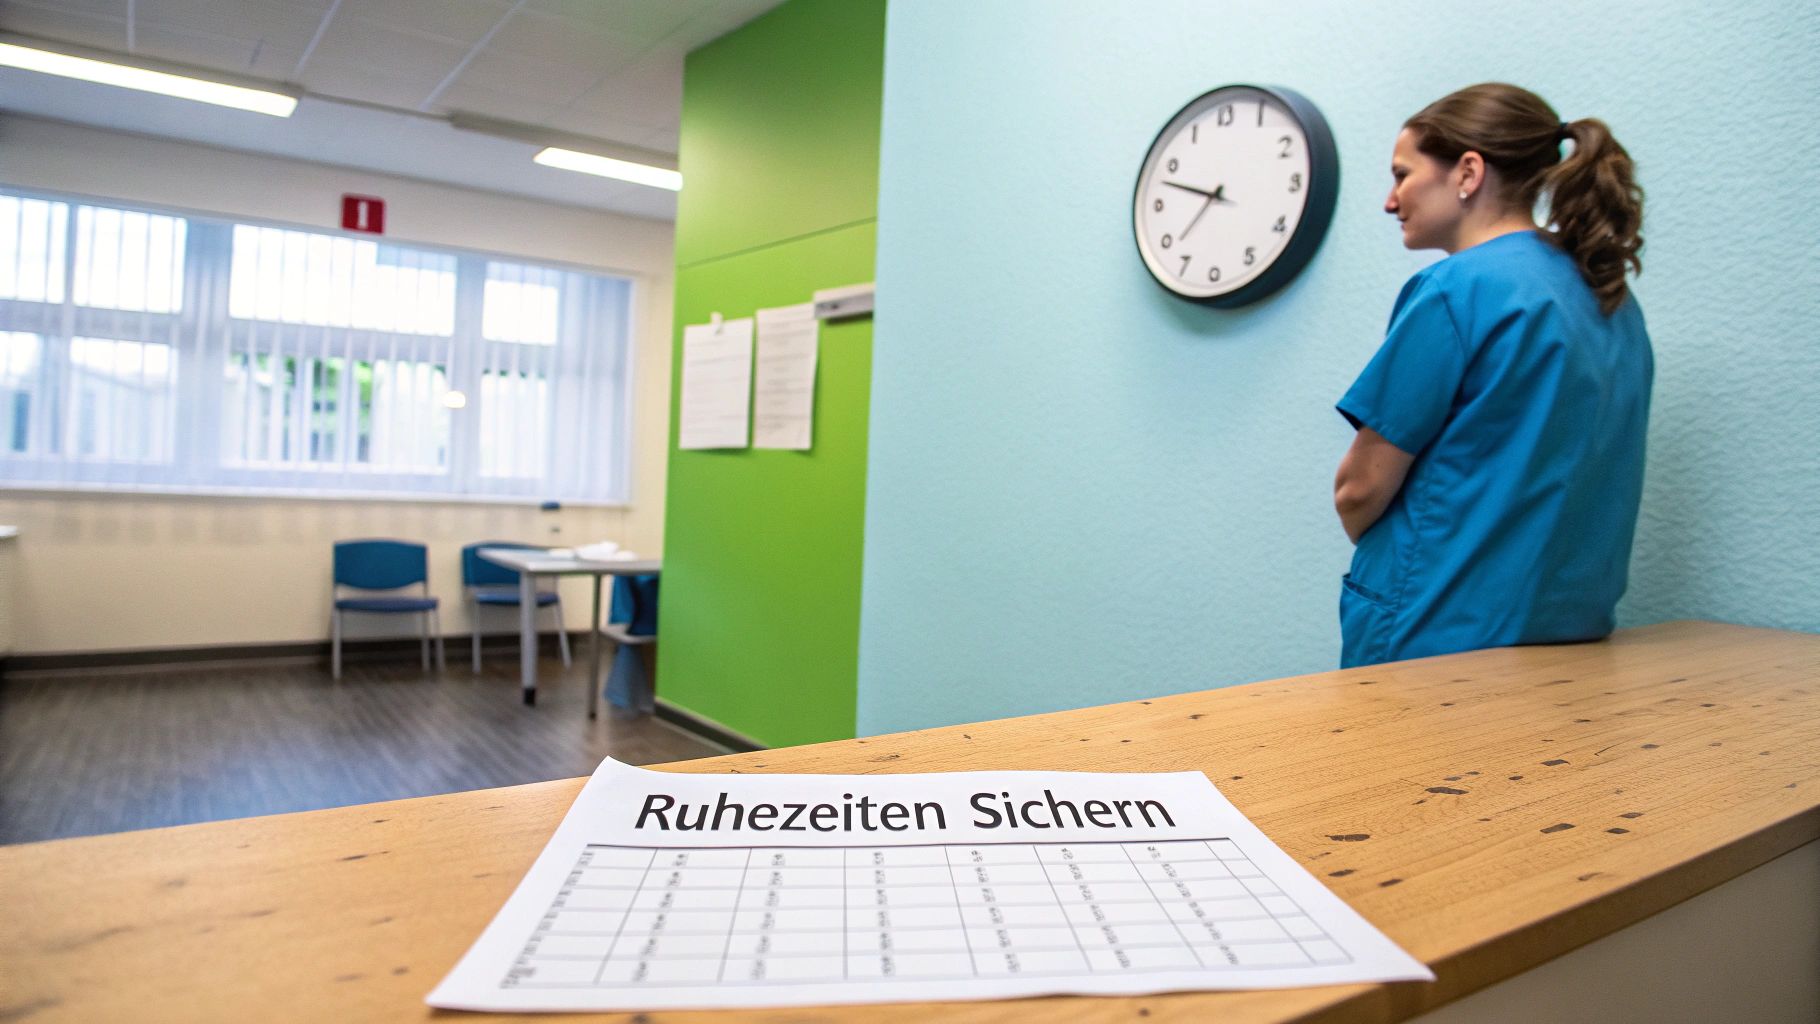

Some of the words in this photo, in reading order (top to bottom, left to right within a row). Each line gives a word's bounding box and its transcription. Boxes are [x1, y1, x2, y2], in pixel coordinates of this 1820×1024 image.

[1278, 136, 1292, 158] 2
[1180, 255, 1192, 277] 7
[1244, 247, 1255, 265] 5
[634, 792, 947, 832] Ruhezeiten
[970, 789, 1176, 829] Sichern
